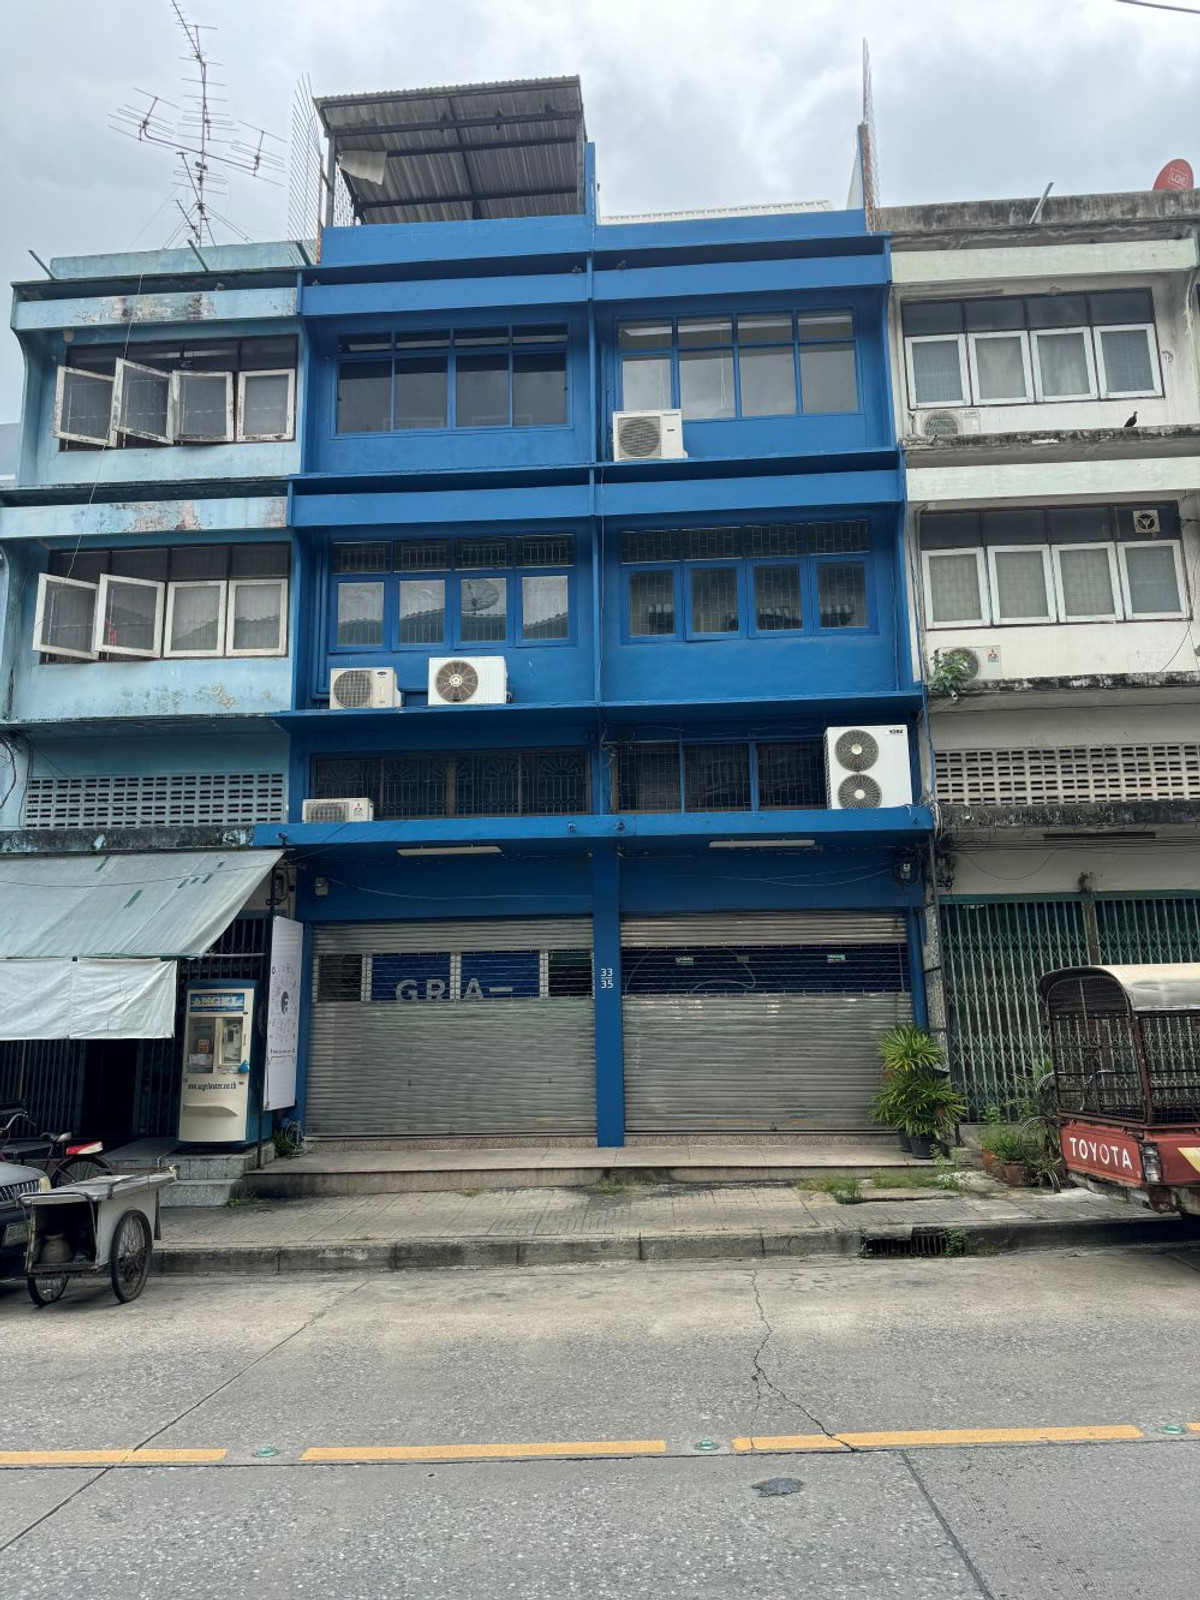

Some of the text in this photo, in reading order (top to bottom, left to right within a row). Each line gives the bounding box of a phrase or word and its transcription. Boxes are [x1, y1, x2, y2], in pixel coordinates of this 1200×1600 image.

[600, 968, 613, 976] 33
[600, 980, 614, 988] 35
[1069, 1137, 1133, 1170] TOYOTA
